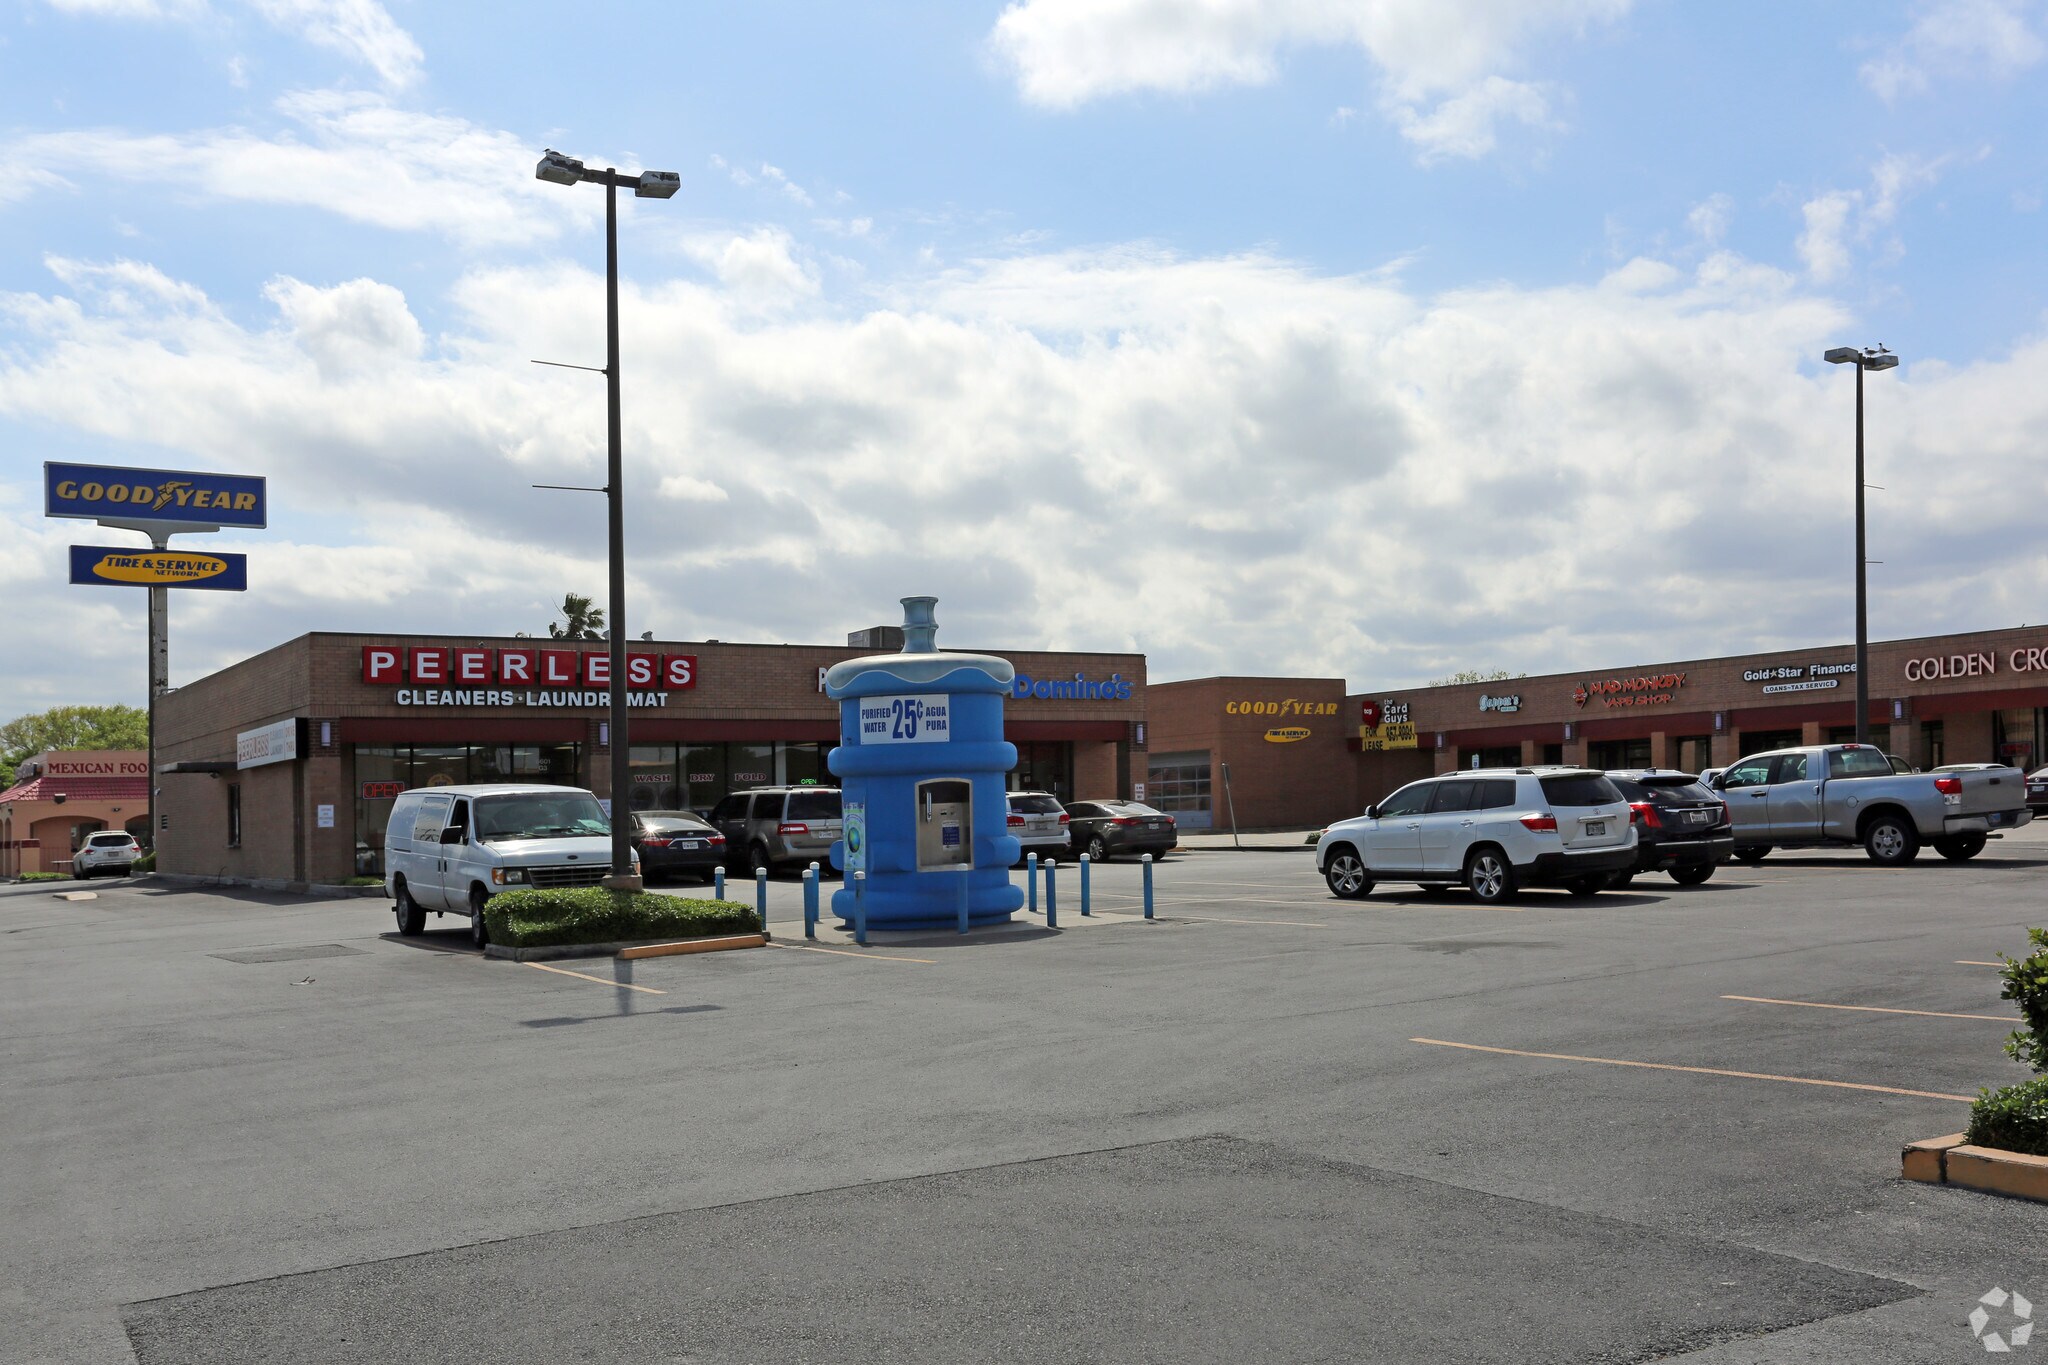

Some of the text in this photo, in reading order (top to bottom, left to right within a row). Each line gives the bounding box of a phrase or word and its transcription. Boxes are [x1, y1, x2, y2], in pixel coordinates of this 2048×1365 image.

[106, 557, 220, 572] TIRE & SERVICE
[154, 569, 200, 577] NETWORK
[370, 651, 691, 685] PEERLESS
[1743, 663, 1857, 681] Gold Star Finance
[1905, 652, 1995, 681] GOLDEN
[1012, 672, 1132, 699] Domino's
[1589, 673, 1686, 695] MAD MONKEY
[1806, 681, 1835, 689] SERVICE
[397, 689, 669, 707] CLEANERS LAUNDRMAT
[1603, 693, 1672, 708] VAPE SHOP
[861, 707, 891, 719] PURIFIED
[925, 706, 946, 717] AGUA
[1384, 703, 1408, 714] Card
[892, 699, 923, 739] 25¢
[1384, 714, 1408, 724] Guys
[864, 722, 887, 733] WATER
[926, 720, 947, 731] PURA
[1365, 727, 1377, 737] FOR
[1365, 740, 1384, 751] LEASE
[48, 763, 150, 774] MEXICAN FOO
[634, 773, 767, 782] WASH DRY FOLD
[364, 783, 403, 798] OPEN
